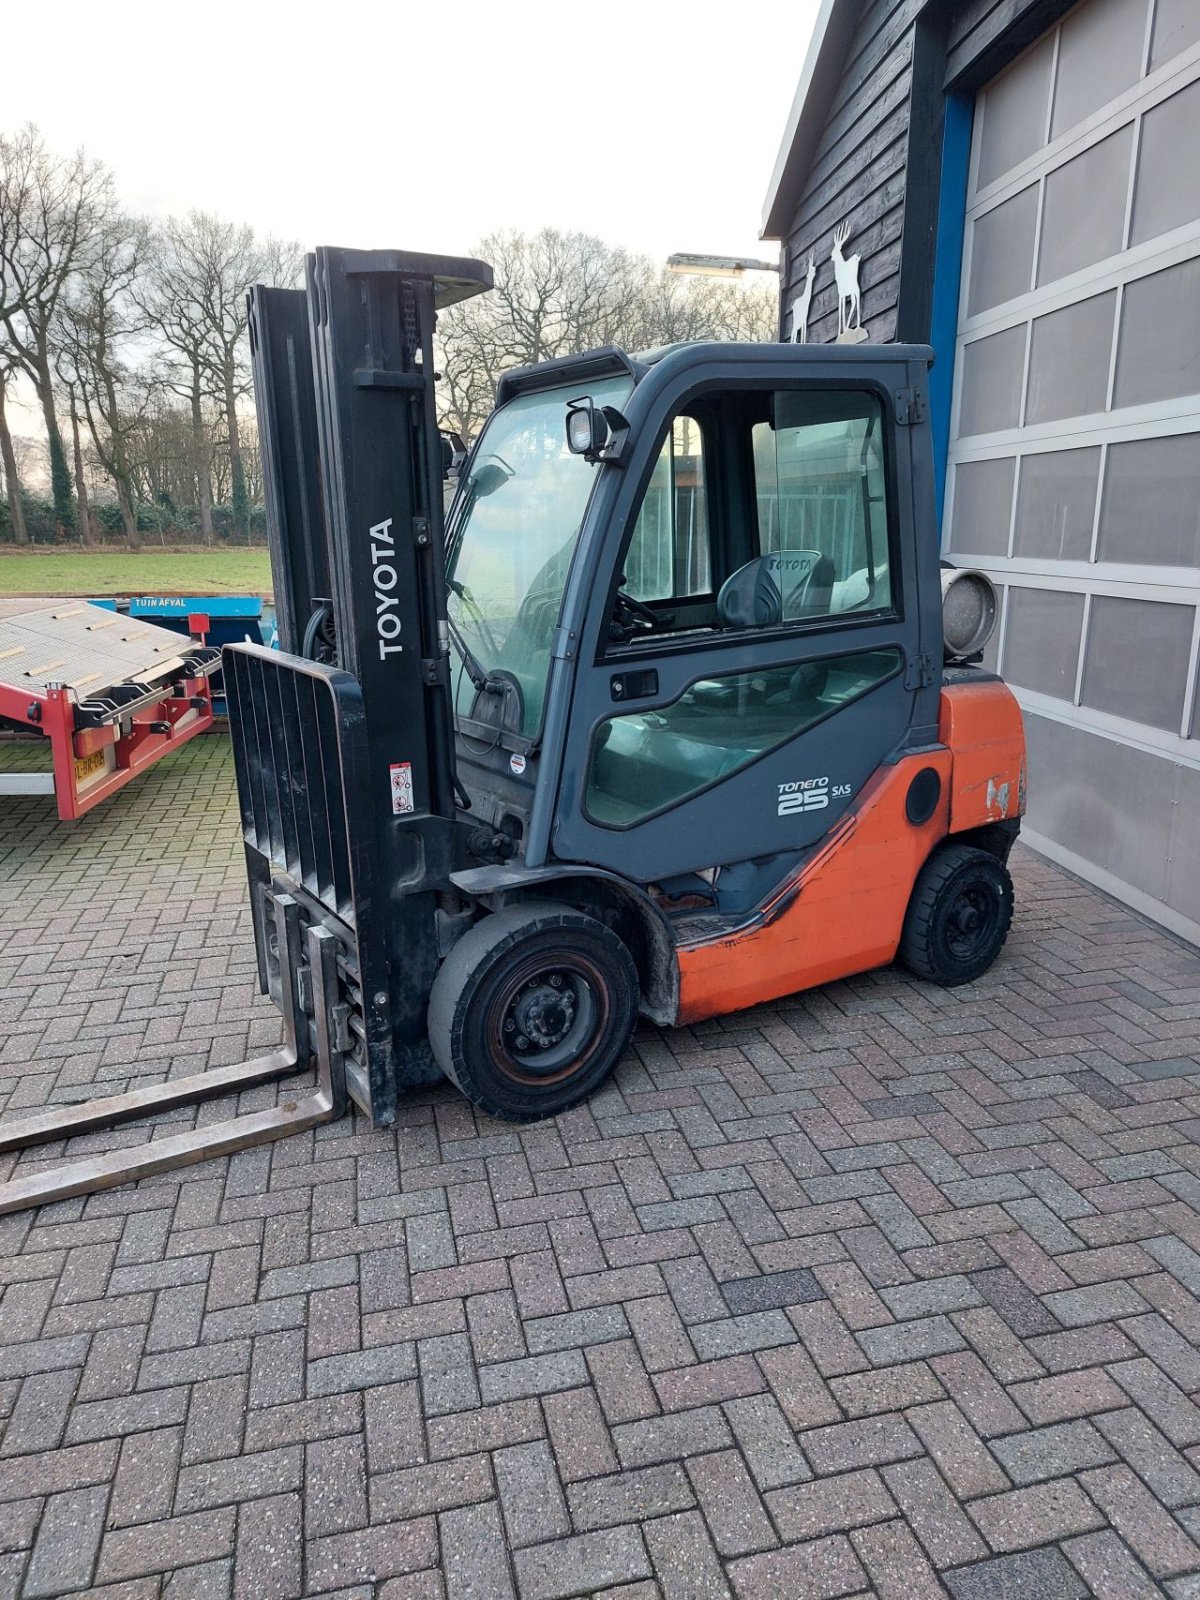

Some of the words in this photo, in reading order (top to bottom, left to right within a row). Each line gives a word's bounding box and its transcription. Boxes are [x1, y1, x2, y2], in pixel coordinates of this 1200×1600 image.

[769, 559, 811, 571] TOYOTA
[369, 517, 403, 661] TOYOTA
[135, 598, 157, 607] TUIN
[158, 598, 187, 608] AFVAL
[777, 787, 829, 816] 25
[831, 783, 851, 797] SAS
